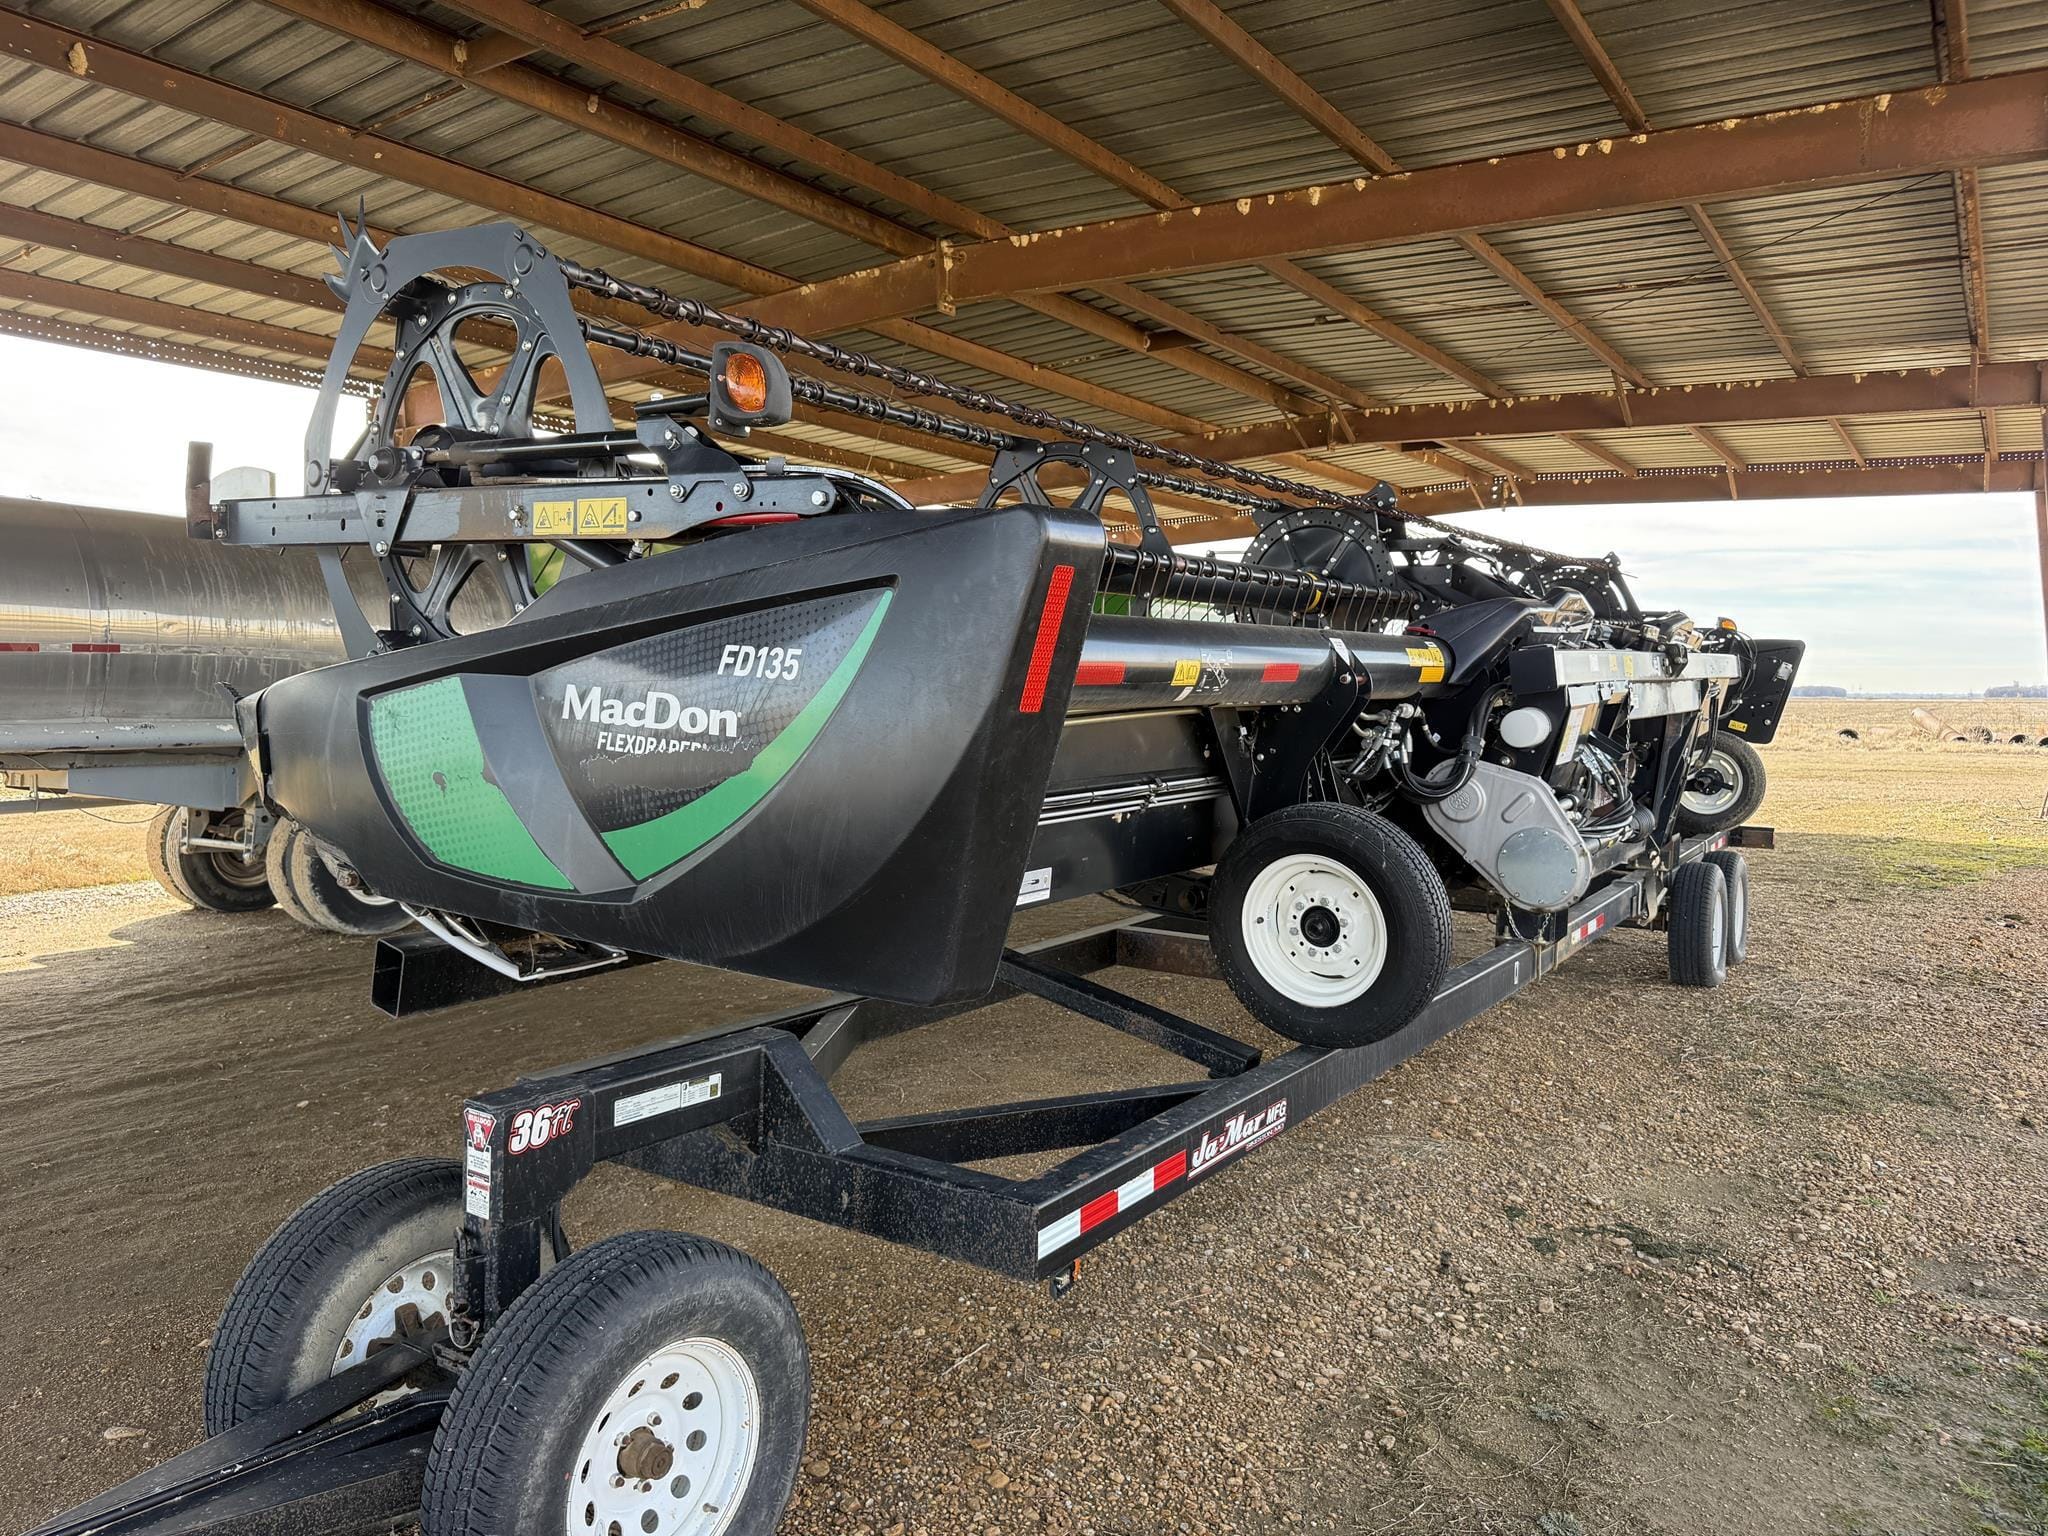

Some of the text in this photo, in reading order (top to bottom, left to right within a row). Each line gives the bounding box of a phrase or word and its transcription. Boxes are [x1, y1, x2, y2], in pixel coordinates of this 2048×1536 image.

[717, 644, 803, 681] FD135
[562, 684, 741, 738] MacDon
[1266, 1100, 1287, 1125] MFG
